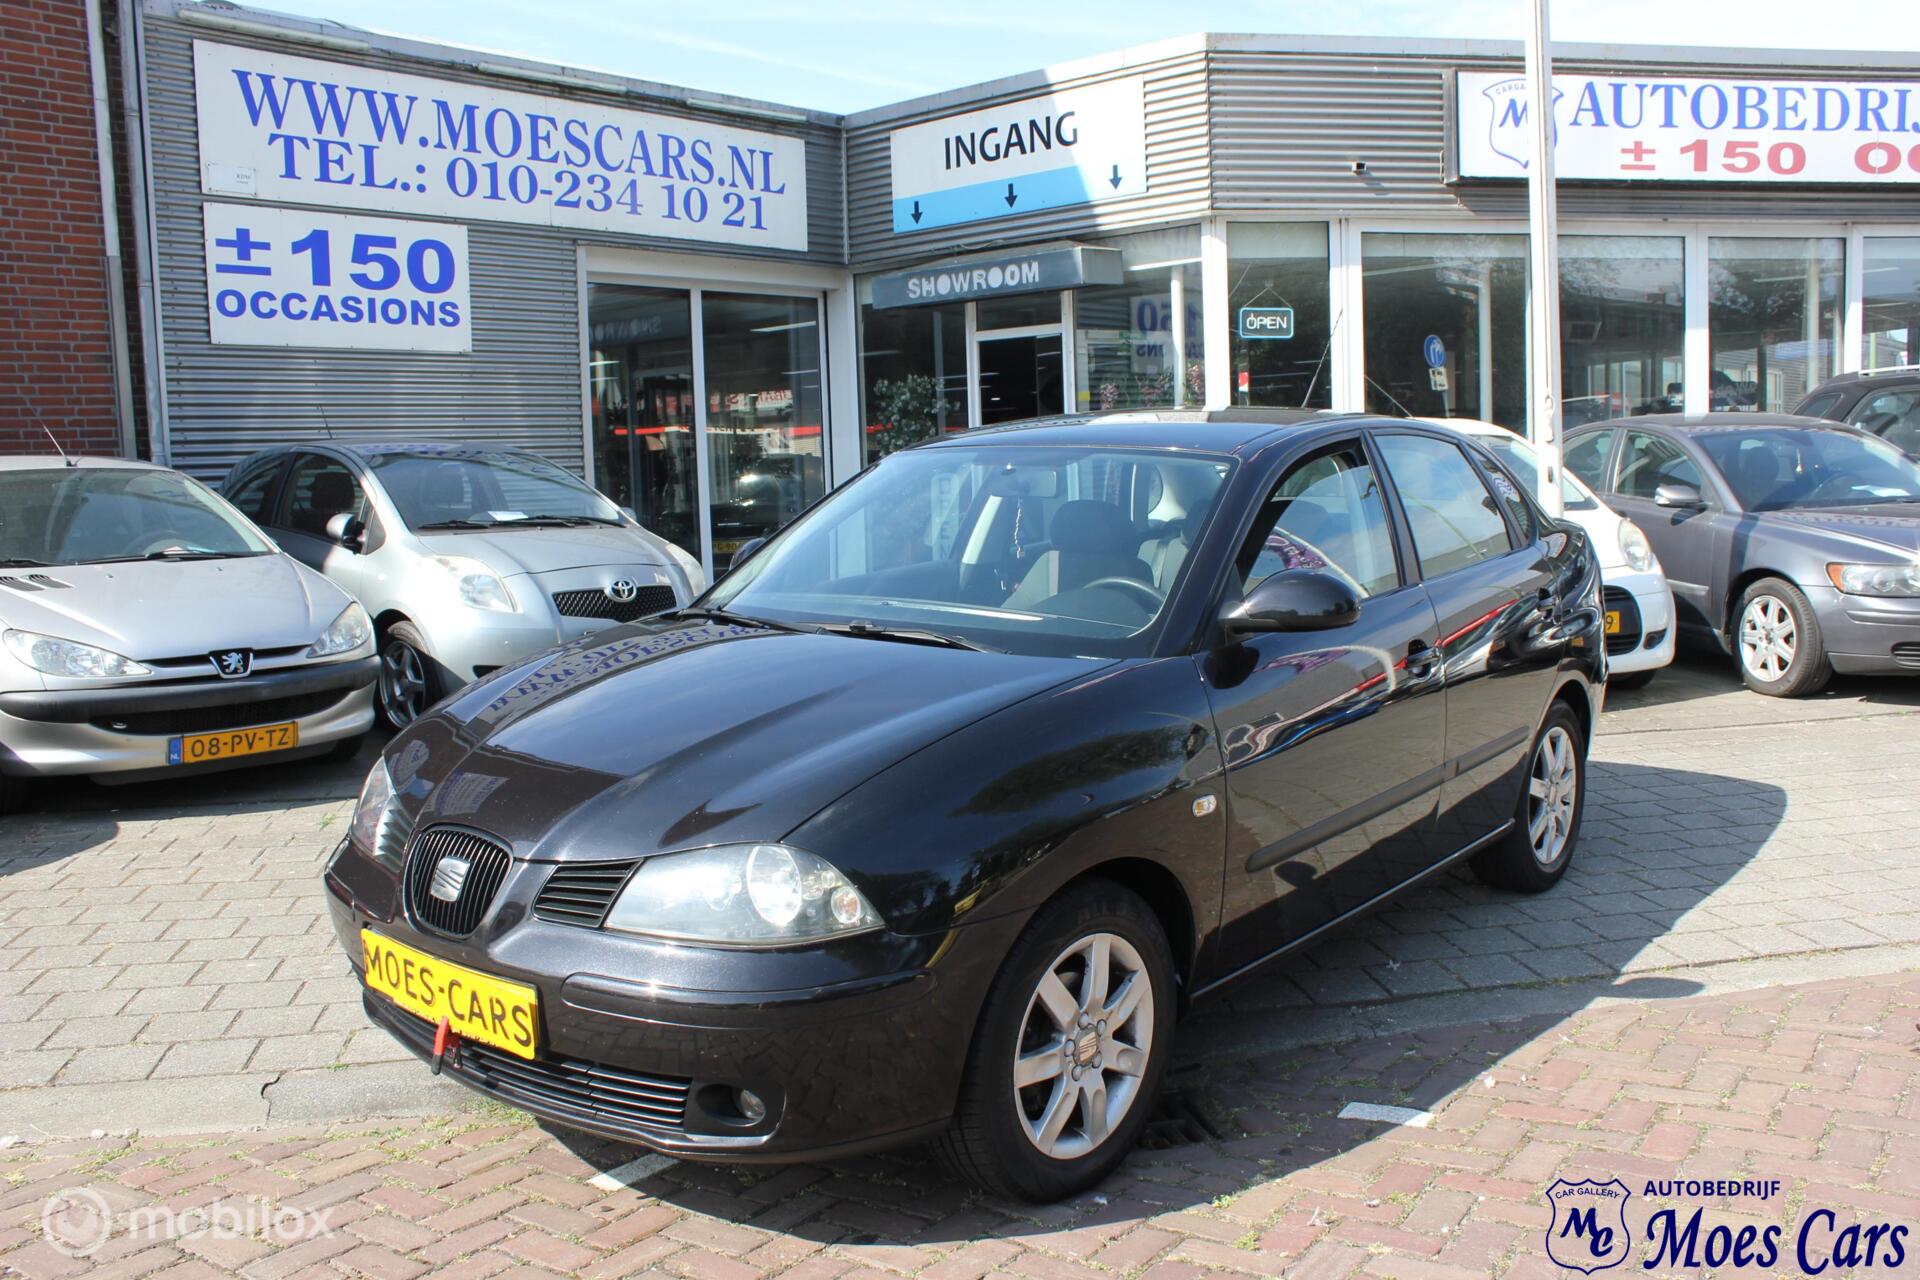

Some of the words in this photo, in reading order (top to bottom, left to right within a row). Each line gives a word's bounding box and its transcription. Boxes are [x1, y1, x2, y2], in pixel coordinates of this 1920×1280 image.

[231, 67, 787, 196] WWW.MOESCARS.NL
[944, 111, 1079, 170] INGANG
[1854, 142, 1920, 175] O
[267, 131, 428, 193] TEL.:
[445, 155, 643, 216] 010-234
[662, 182, 709, 223] 10
[721, 190, 768, 231] 21
[907, 261, 1041, 299] SHOWROOM
[213, 287, 461, 329] OCCASIONS
[1246, 314, 1288, 330] OPEN
[170, 752, 180, 760] NL
[191, 727, 289, 758] 08-PV-TZ
[365, 939, 532, 1048] MOES-CARS
